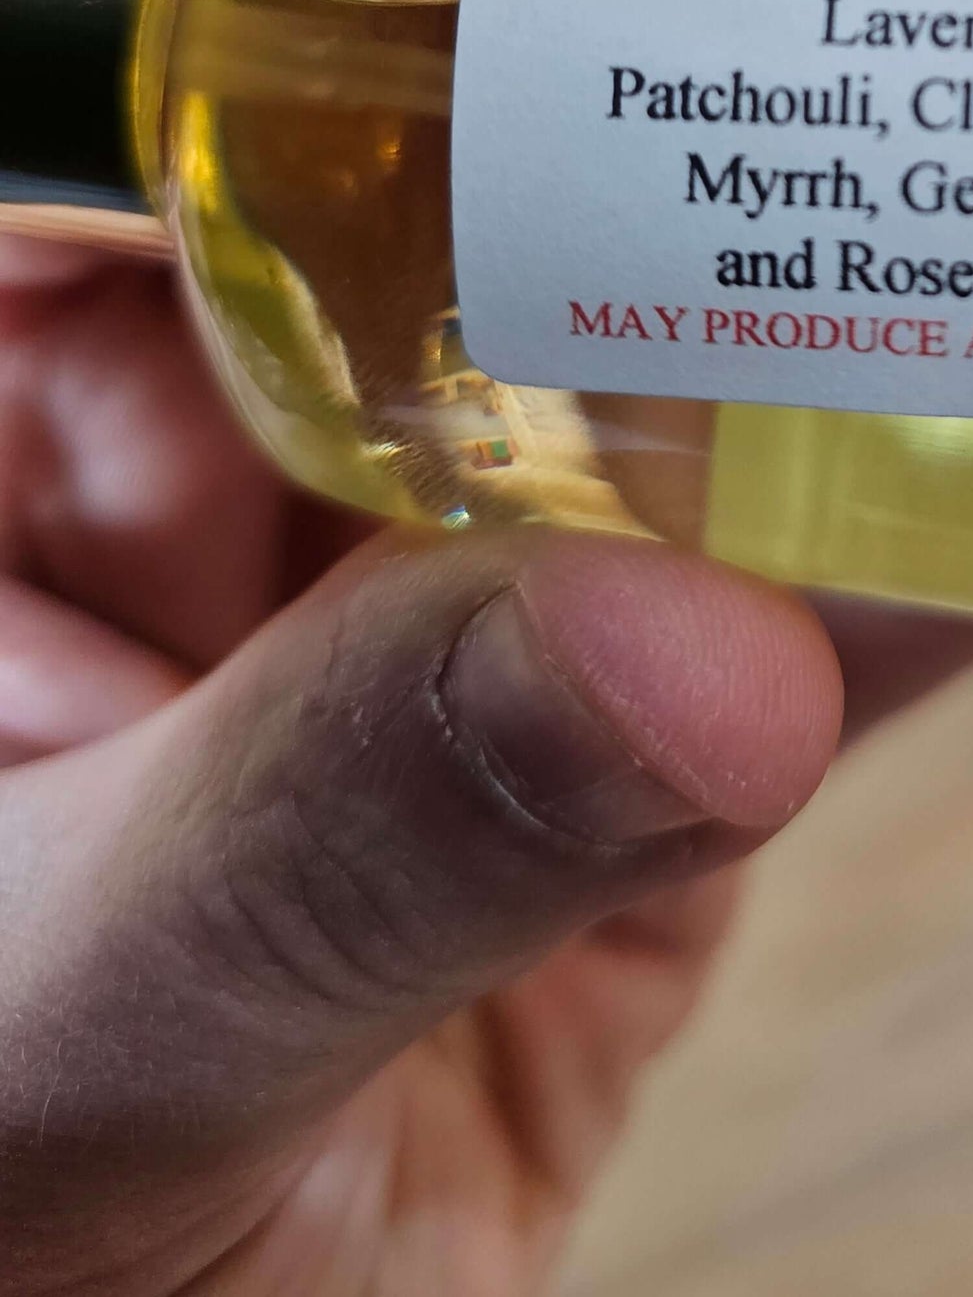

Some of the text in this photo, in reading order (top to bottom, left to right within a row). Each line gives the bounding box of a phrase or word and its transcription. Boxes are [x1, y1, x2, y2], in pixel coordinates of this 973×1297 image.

[606, 65, 890, 139] Patchouli,
[683, 152, 880, 223] Myrrh,
[715, 236, 818, 292] and
[568, 301, 687, 342] MAY
[703, 309, 948, 357] PRODUCE
